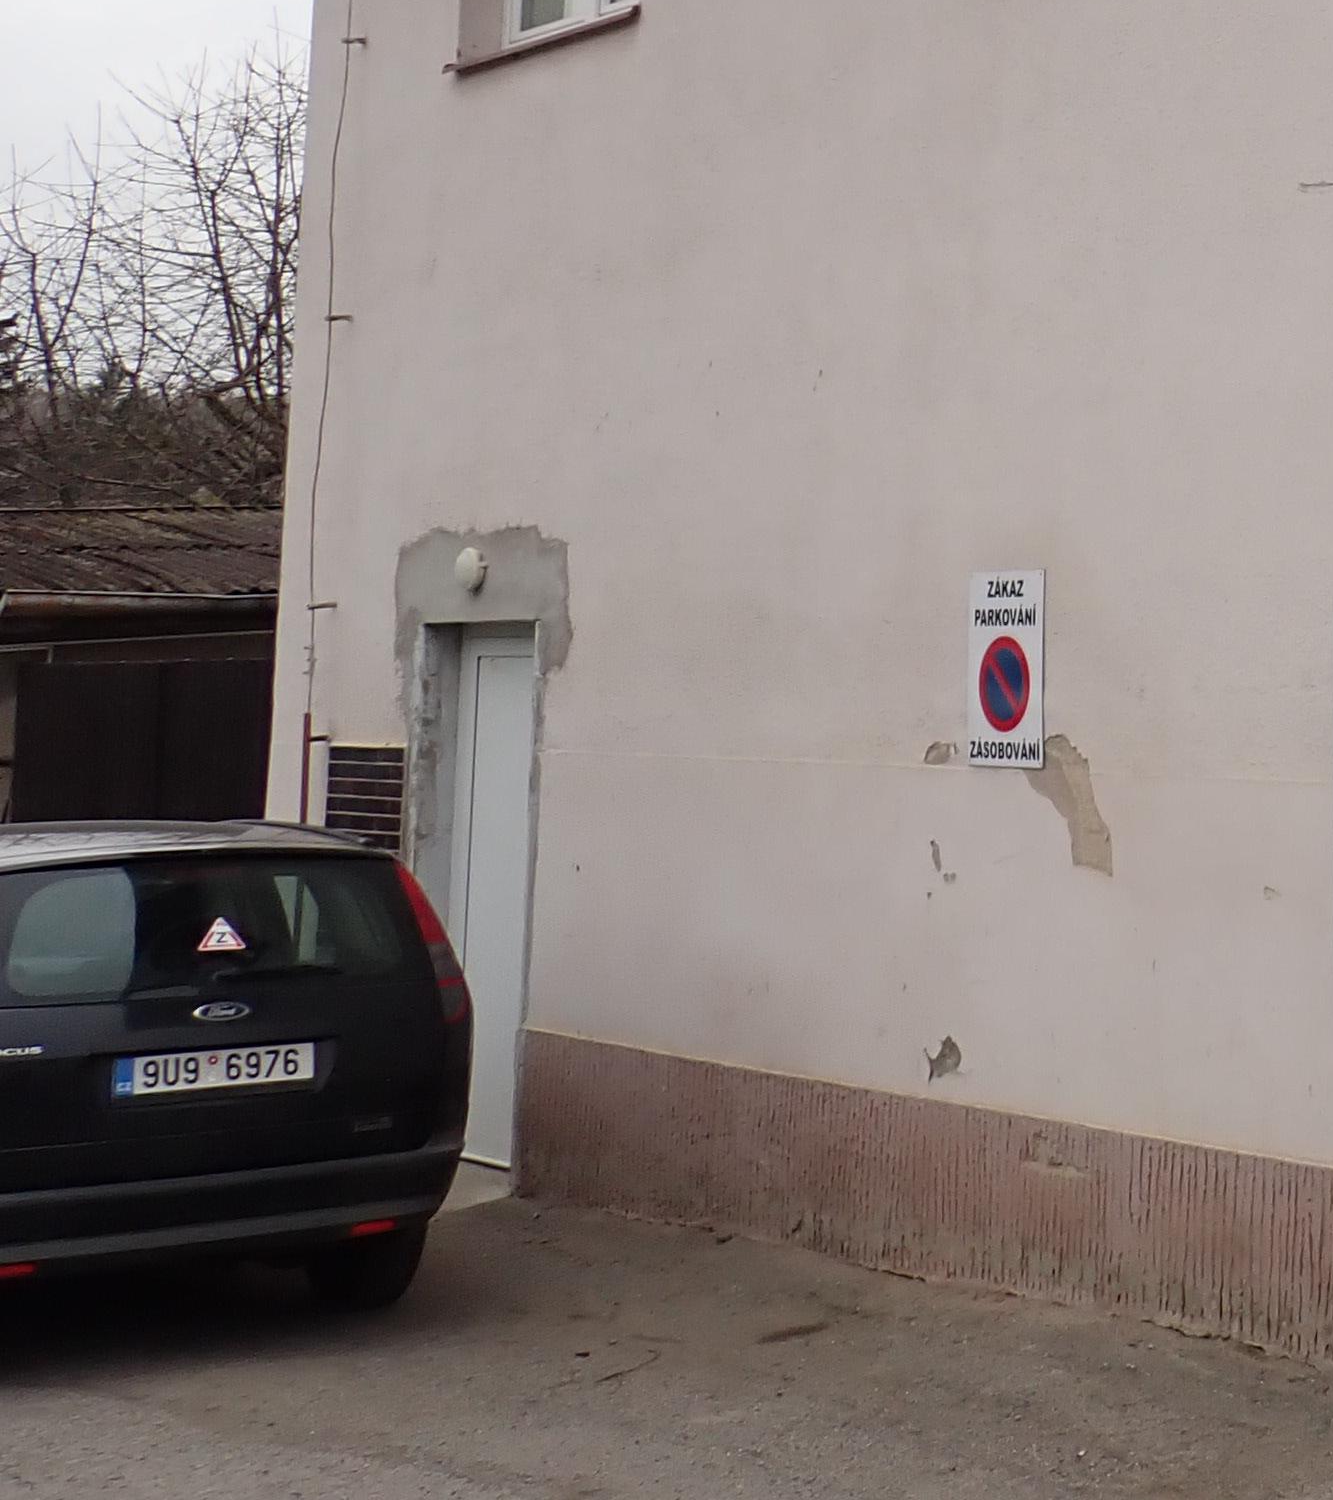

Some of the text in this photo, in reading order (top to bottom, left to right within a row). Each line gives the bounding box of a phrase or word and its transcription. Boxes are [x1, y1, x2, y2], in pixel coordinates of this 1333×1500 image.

[987, 576, 1024, 598] ZÁKAZ
[974, 603, 1037, 627] PARKOVÁNÍ
[970, 737, 1041, 762] ZÁSOBOVÁNÍ
[0, 1046, 44, 1057] CUS
[143, 1057, 200, 1088] 9U9
[225, 1049, 300, 1080] 6976
